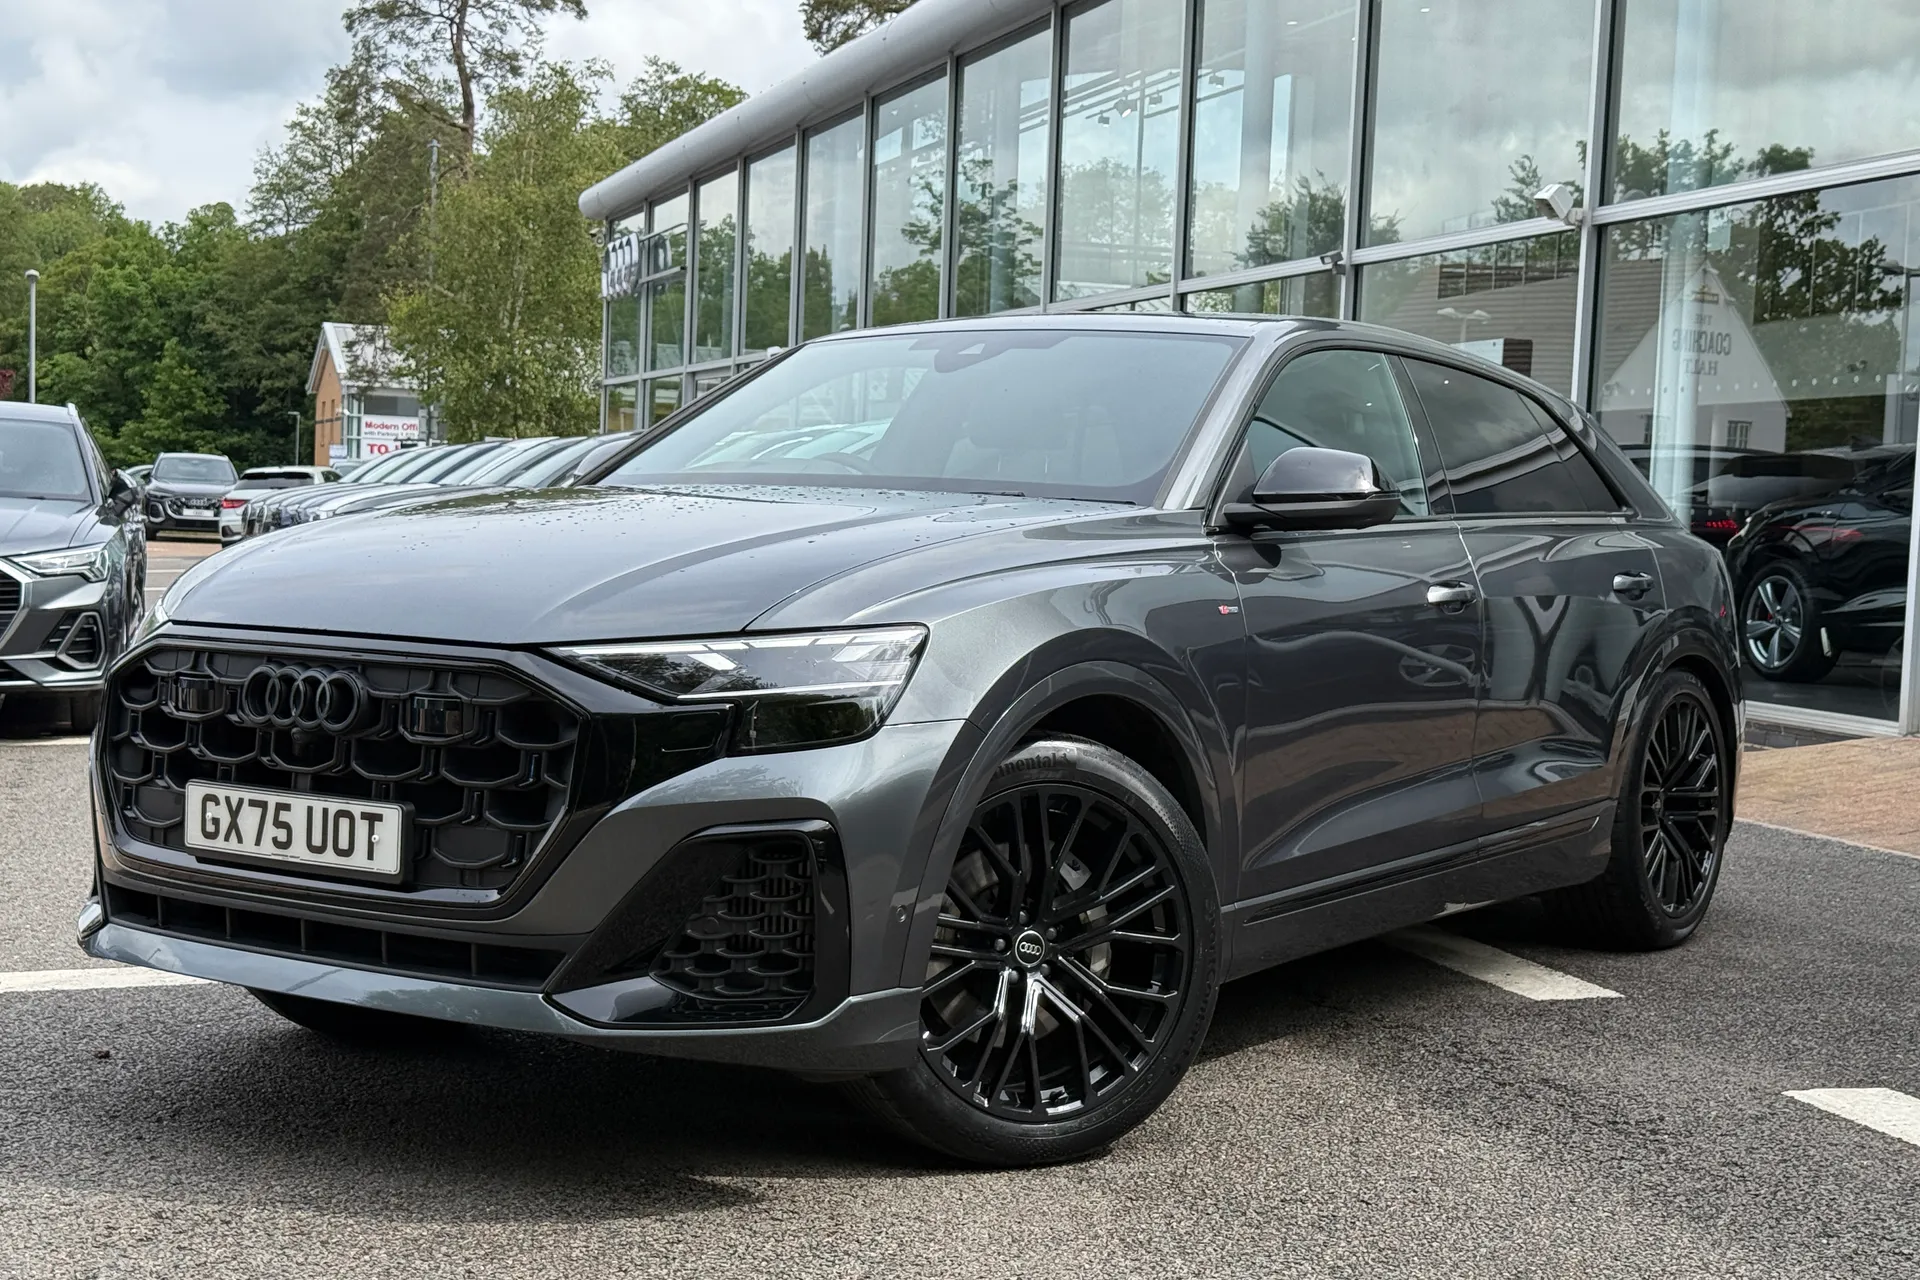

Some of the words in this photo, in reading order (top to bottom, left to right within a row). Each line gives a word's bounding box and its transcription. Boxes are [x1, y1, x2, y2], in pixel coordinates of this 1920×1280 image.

[365, 421, 399, 430] Modern
[402, 423, 418, 431] Offi
[367, 443, 389, 455] TO
[995, 753, 1057, 778] inental
[200, 793, 293, 850] GX75
[306, 805, 384, 861] UOT
